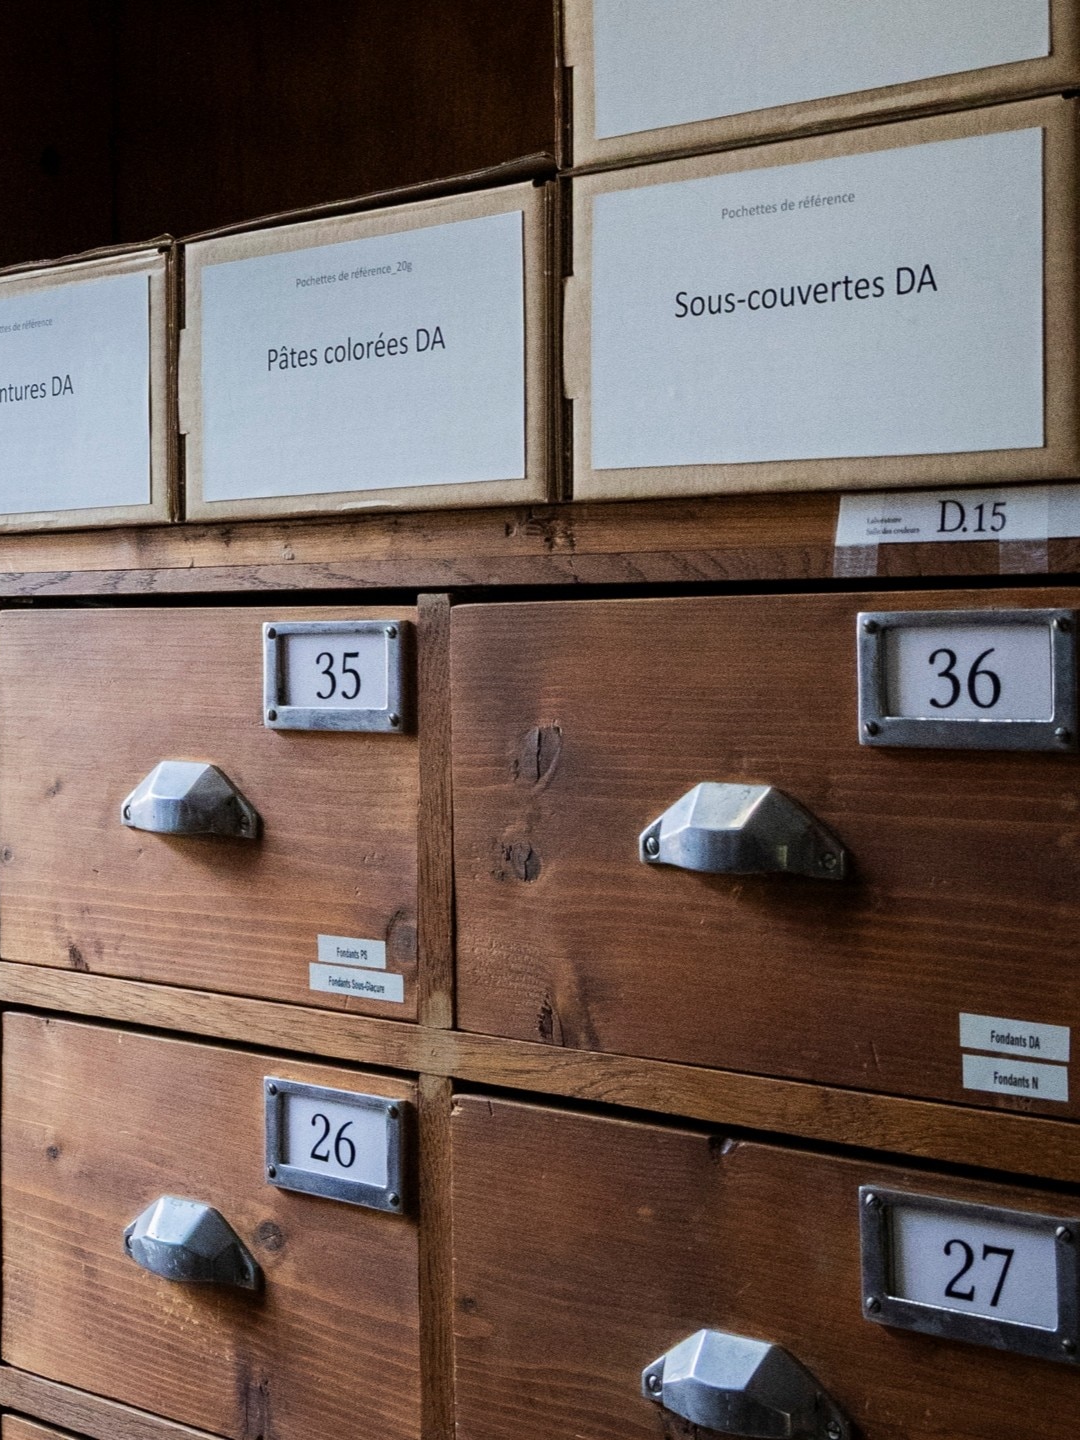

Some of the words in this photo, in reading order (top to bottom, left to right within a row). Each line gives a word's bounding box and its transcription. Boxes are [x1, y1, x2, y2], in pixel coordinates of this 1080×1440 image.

[721, 202, 778, 221] Pochettes
[780, 199, 796, 213] de
[798, 191, 856, 210] référence
[295, 272, 337, 289] Pochettes
[337, 269, 350, 282] de
[350, 259, 413, 280] référence_20g
[675, 272, 885, 319] Sous-couvertes
[895, 263, 938, 296] DA
[12, 322, 21, 332] de
[21, 317, 53, 330] référence
[267, 345, 318, 372] Pâtes
[323, 332, 409, 365] colorées
[415, 325, 446, 354] DA
[51, 374, 74, 397] DA
[937, 499, 1007, 533] D.15
[315, 652, 362, 700] 35
[928, 647, 1002, 709] 36
[336, 946, 360, 960] Fondants
[990, 1030, 1027, 1048] Fondants
[1028, 1035, 1041, 1050] DA
[993, 1071, 1030, 1089] Fondants
[1031, 1076, 1039, 1090] N
[310, 1112, 357, 1169] 26
[943, 1239, 1016, 1308] 27
